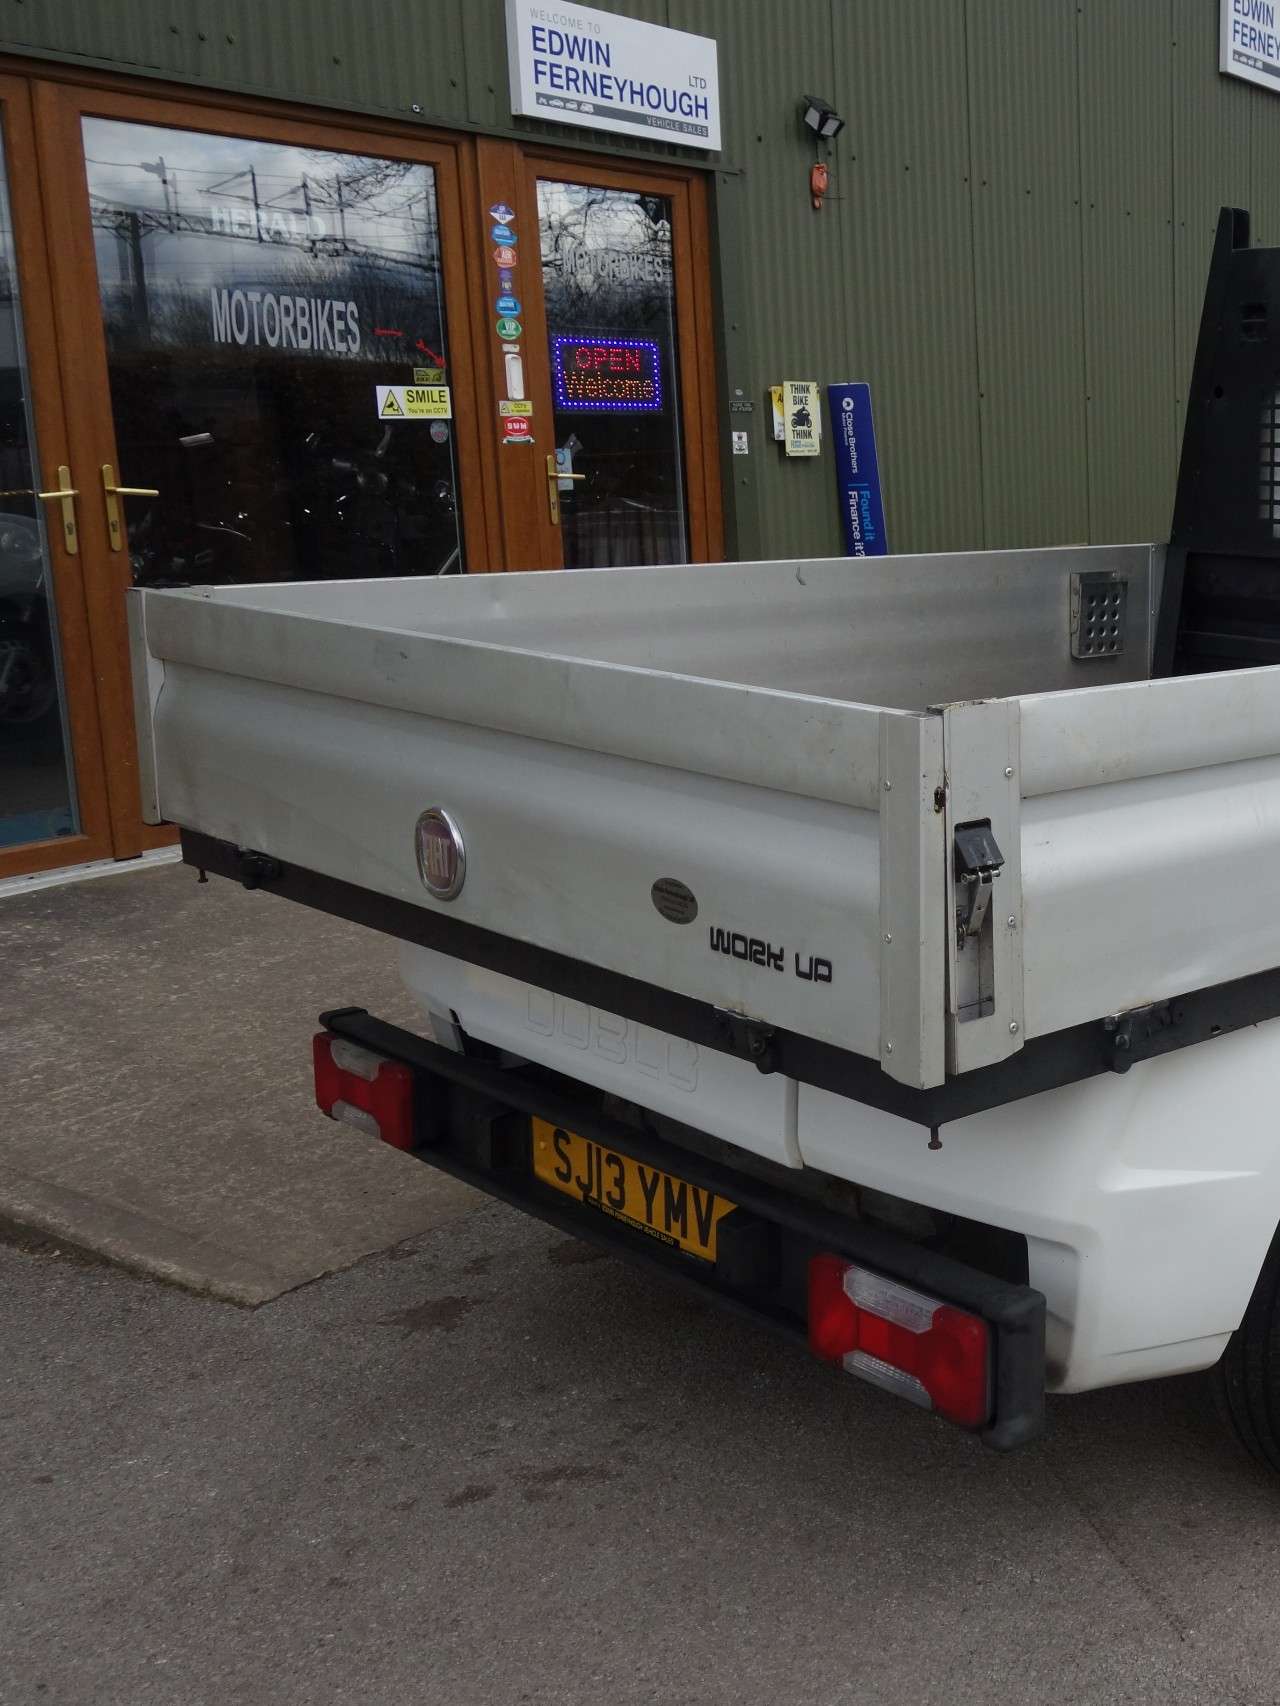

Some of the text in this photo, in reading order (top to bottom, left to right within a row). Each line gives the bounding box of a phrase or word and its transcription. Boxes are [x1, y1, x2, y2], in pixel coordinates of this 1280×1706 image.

[530, 8, 600, 34] WELCOME TO
[1233, 0, 1274, 28] EDWIN
[532, 26, 611, 68] EDWIN
[534, 59, 708, 120] FERNEYHOUGH
[688, 75, 707, 90] LTD
[646, 115, 708, 137] VEHICLE SALES
[211, 207, 326, 240] HERALD
[211, 287, 361, 353] MOTORBIKES
[576, 347, 641, 371] OPEN
[406, 389, 447, 403] SMILE
[564, 371, 654, 398] Welcome
[790, 384, 811, 395] THINK
[433, 407, 448, 415] CCTV
[793, 396, 809, 406] BIKE
[792, 429, 813, 440] THINK
[845, 412, 858, 474] Close Brothers
[848, 491, 861, 540] Finance
[861, 490, 876, 541] Found it
[710, 926, 833, 984] WORK UP
[553, 1128, 717, 1248] SJ13 YMV
